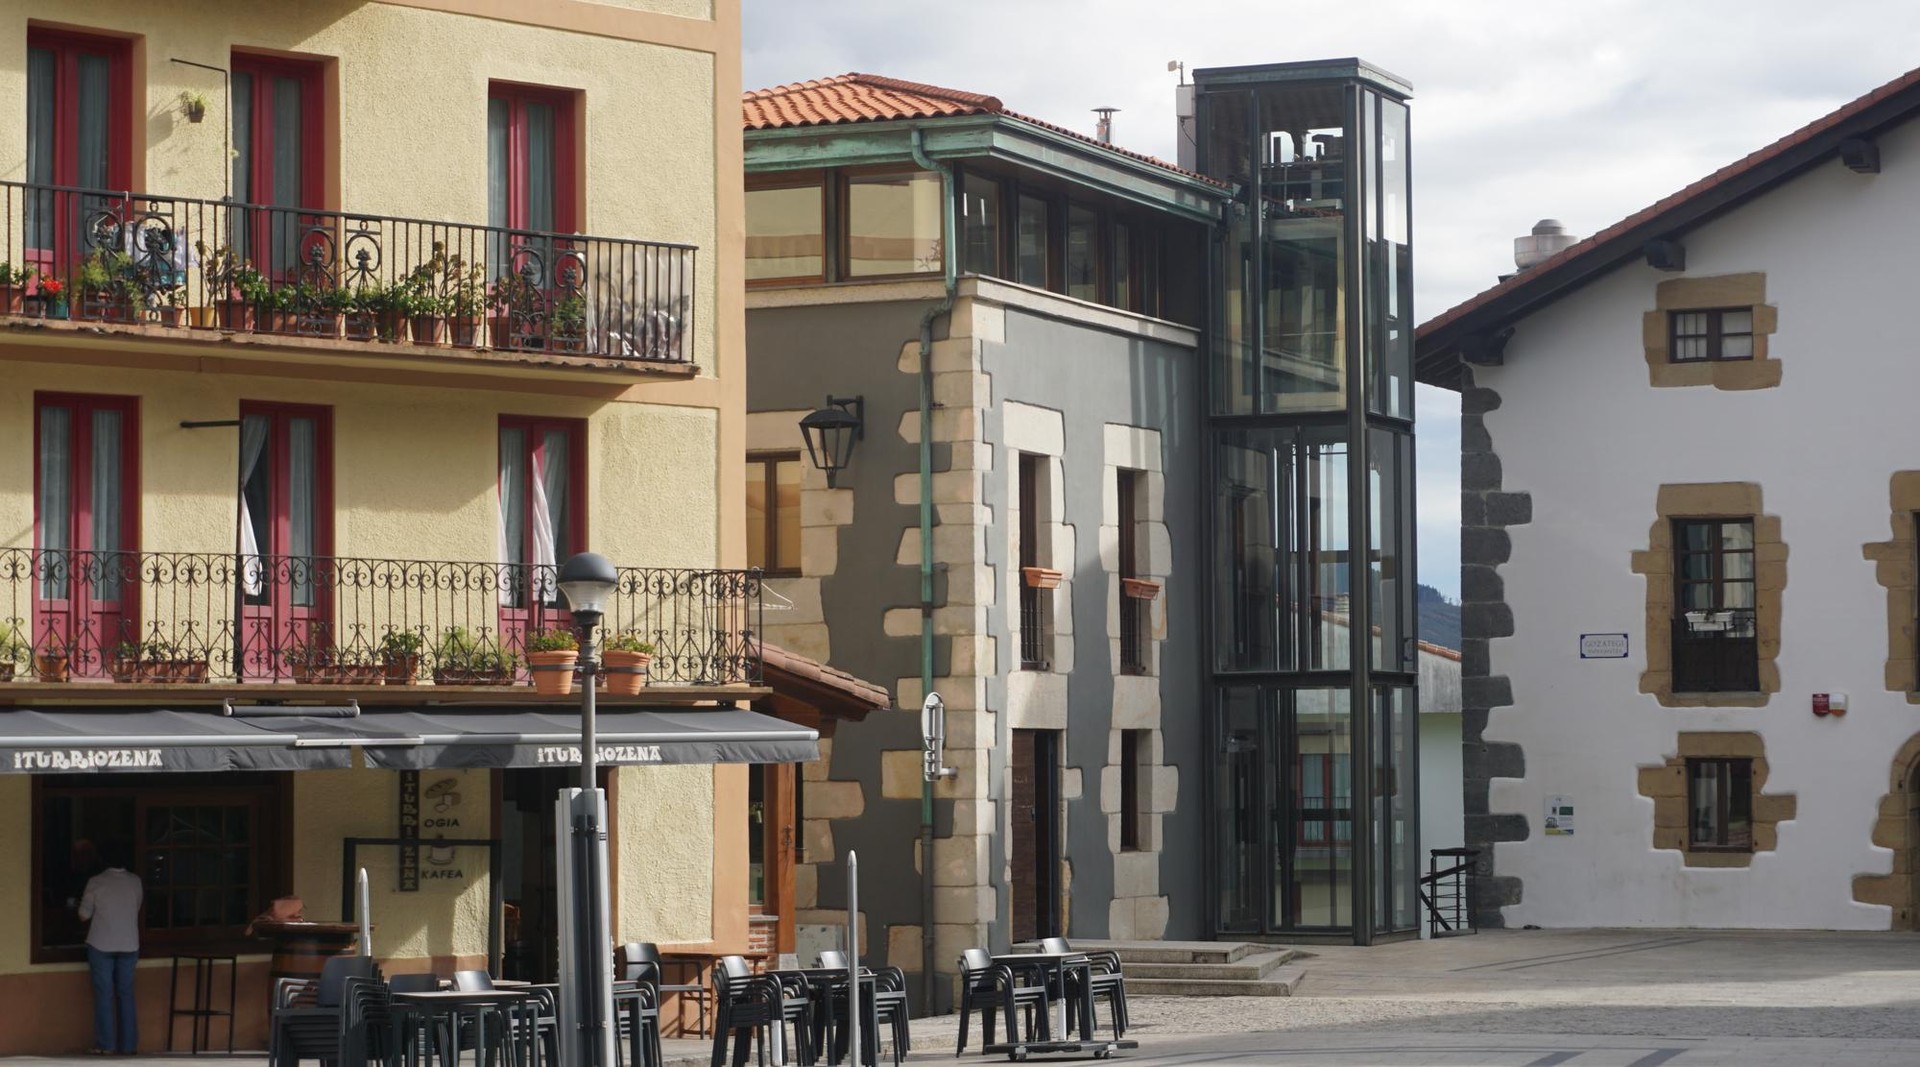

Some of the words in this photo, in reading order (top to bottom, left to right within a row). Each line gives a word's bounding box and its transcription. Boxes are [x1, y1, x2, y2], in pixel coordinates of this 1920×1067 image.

[537, 745, 662, 763] iTURiOZENA
[424, 818, 460, 828] OGIA
[402, 772, 417, 889] iTURRiZENA
[421, 869, 463, 880] KAFEA
